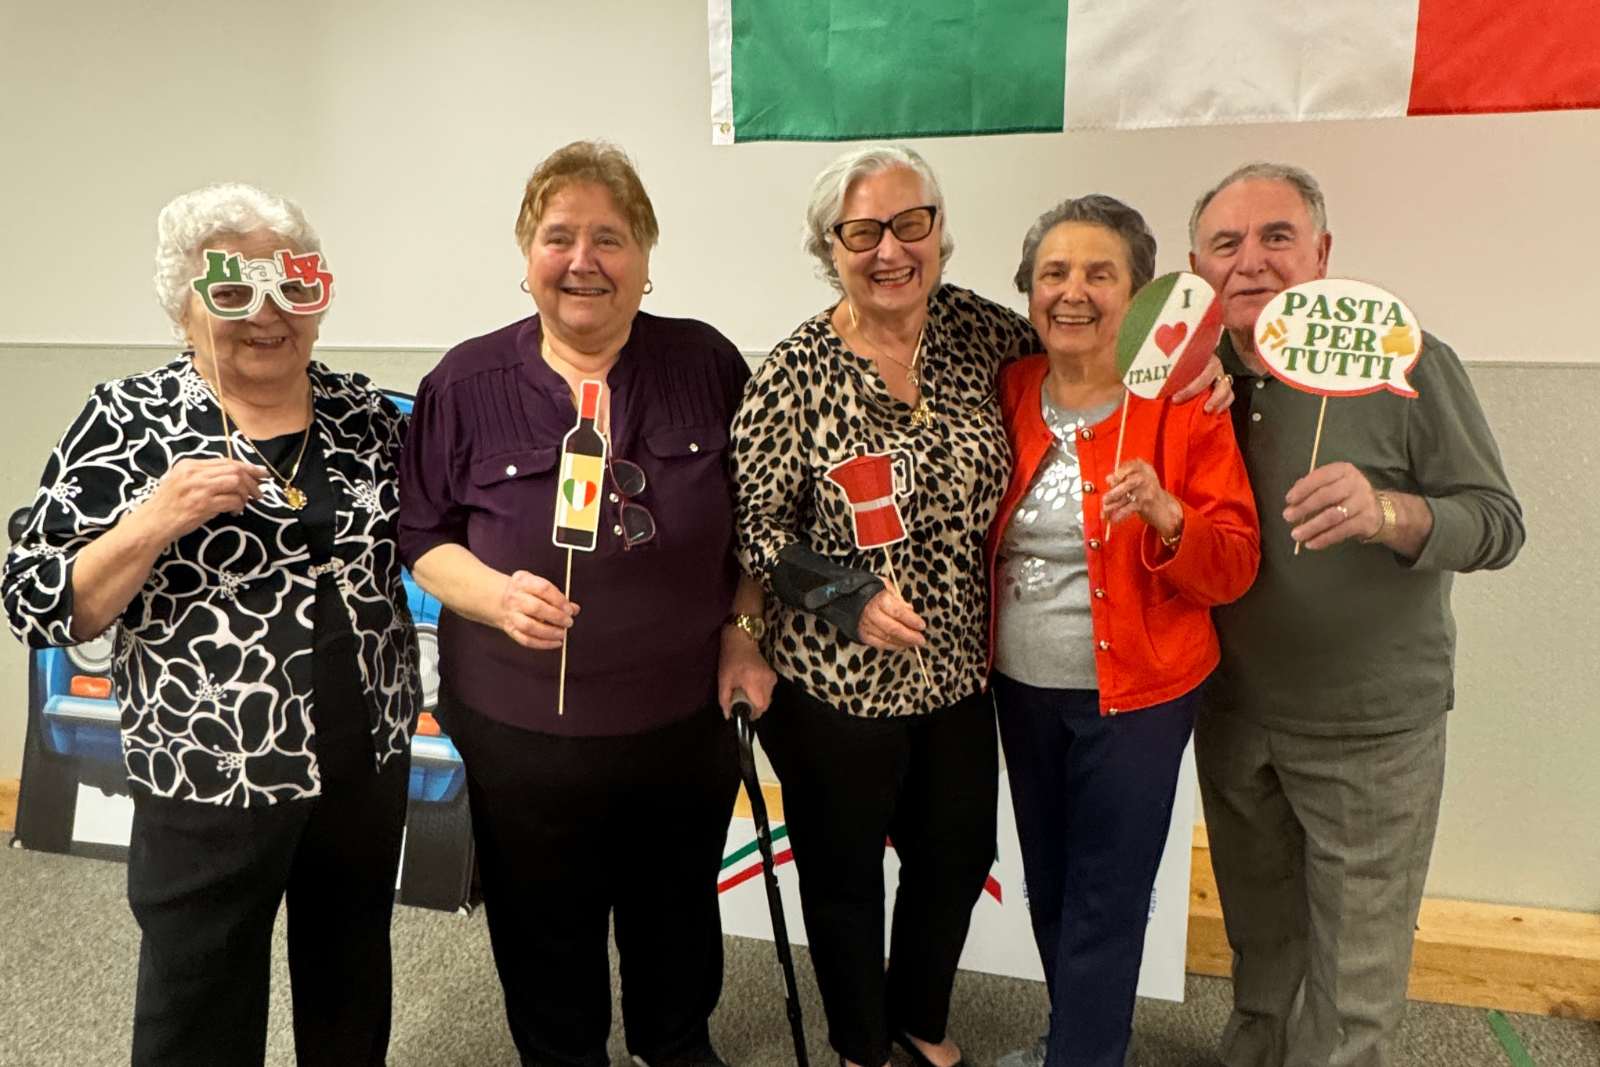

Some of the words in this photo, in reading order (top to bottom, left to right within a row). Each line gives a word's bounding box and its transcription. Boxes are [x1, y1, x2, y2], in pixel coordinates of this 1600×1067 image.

[1181, 288, 1193, 309] I
[1281, 292, 1407, 327] PASTA
[1304, 323, 1377, 352] PER
[1128, 363, 1172, 386] ITALY
[1281, 347, 1395, 380] TUTTI
